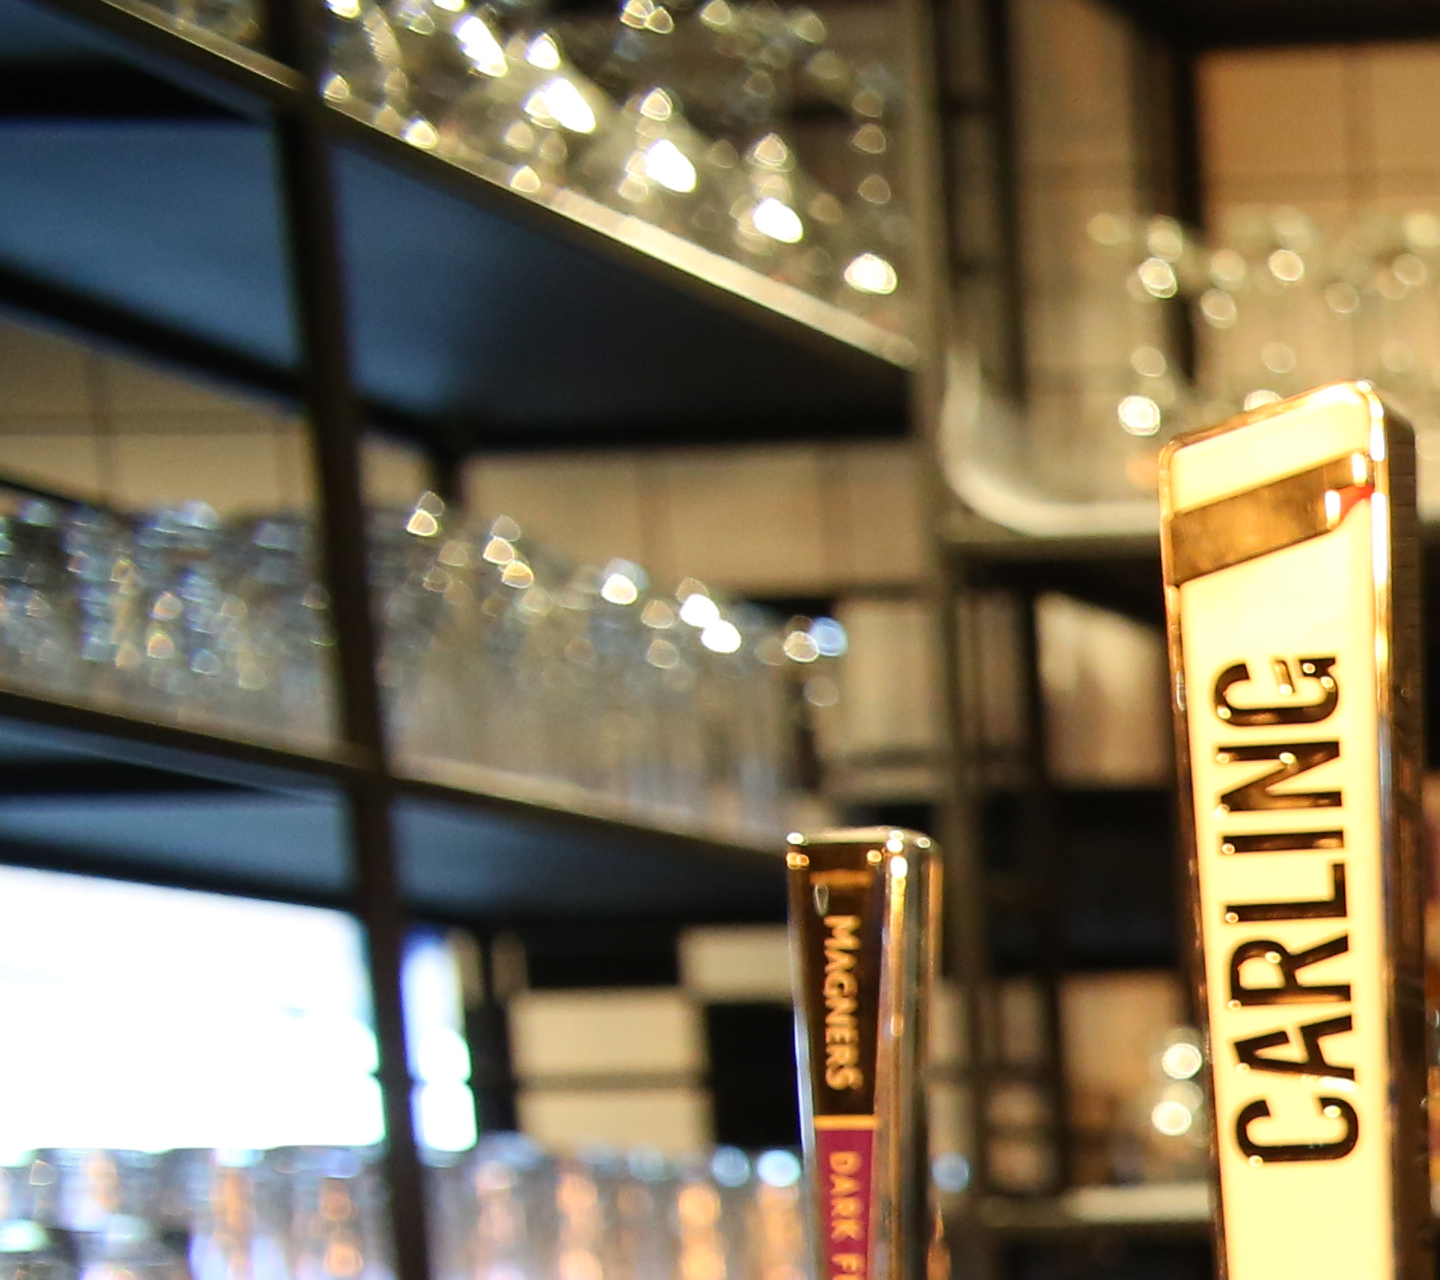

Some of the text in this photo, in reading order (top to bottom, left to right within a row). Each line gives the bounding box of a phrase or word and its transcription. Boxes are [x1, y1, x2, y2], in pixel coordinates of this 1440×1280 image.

[1212, 655, 1363, 1165] CARLING
[821, 914, 863, 1091] MAGNERS
[827, 1150, 864, 1240] DARK
